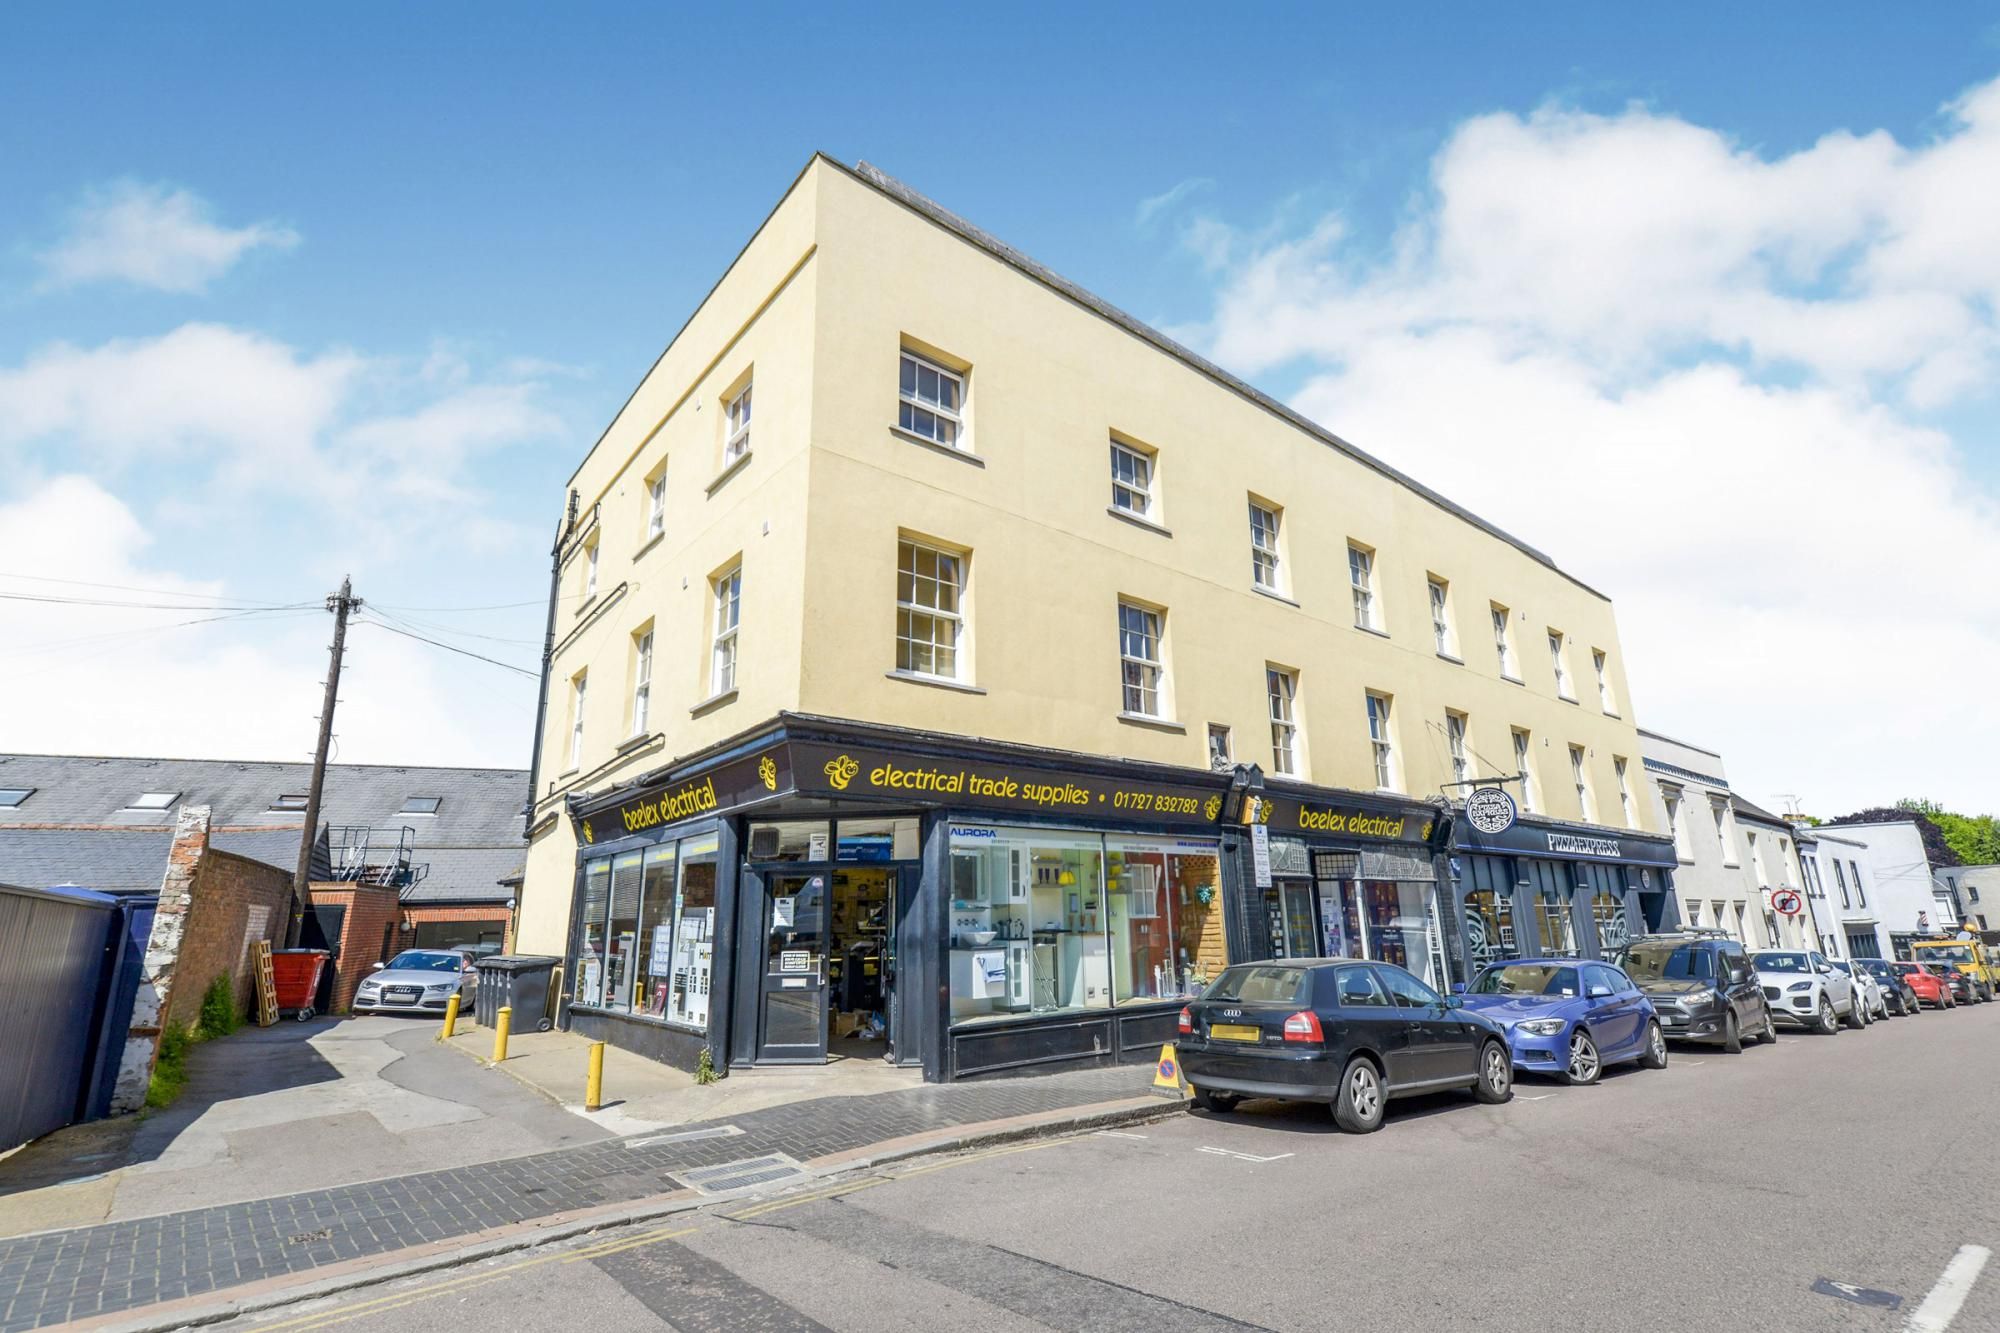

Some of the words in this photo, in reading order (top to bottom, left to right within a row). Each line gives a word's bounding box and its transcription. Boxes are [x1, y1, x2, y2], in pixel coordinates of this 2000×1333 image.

[622, 800, 661, 832] beelex
[660, 776, 718, 821] electrical
[869, 763, 964, 793] electrical
[969, 773, 1018, 798] trade
[1022, 783, 1089, 806] supplies
[1113, 791, 1154, 810] 01727
[1154, 794, 1199, 815] 832782
[950, 827, 997, 838] AURORA
[1299, 805, 1346, 832] beelex
[1348, 816, 1405, 838] electrical
